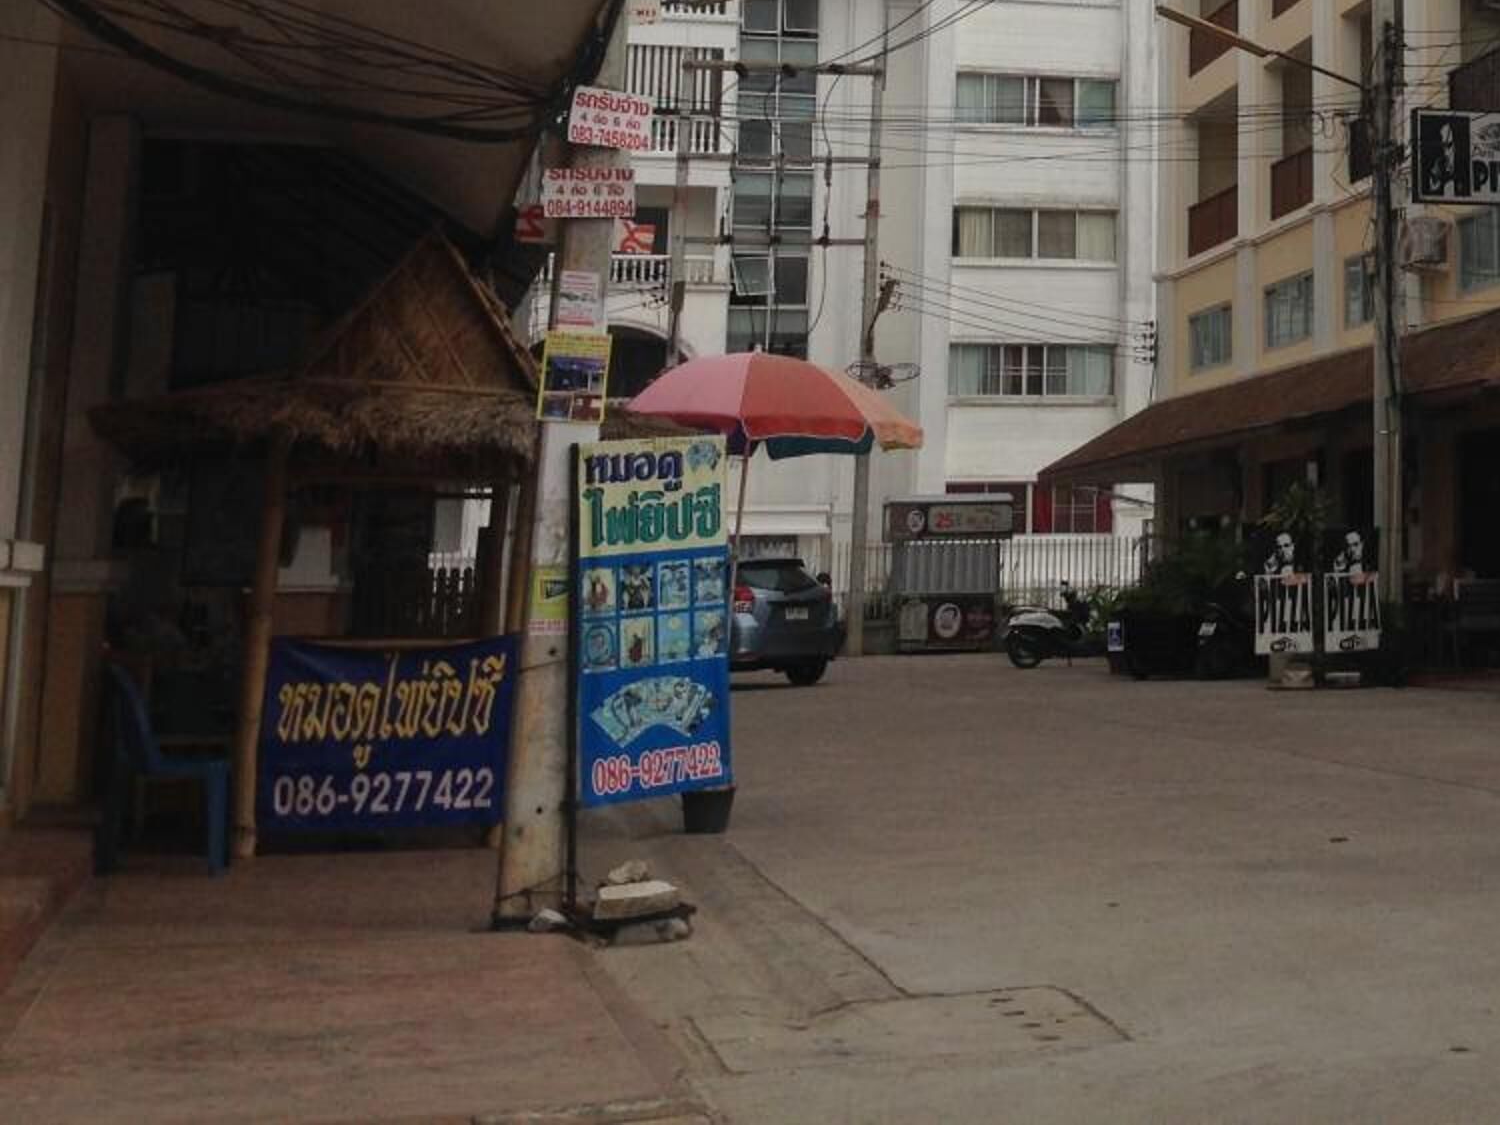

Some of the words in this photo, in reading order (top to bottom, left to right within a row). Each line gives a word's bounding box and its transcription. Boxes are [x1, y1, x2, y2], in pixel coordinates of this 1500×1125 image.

[584, 450, 684, 492] หมอดู
[583, 483, 722, 549] ไพ่ยิปซี
[273, 768, 494, 817] 086-9277422
[592, 741, 722, 795] 086-9277422
